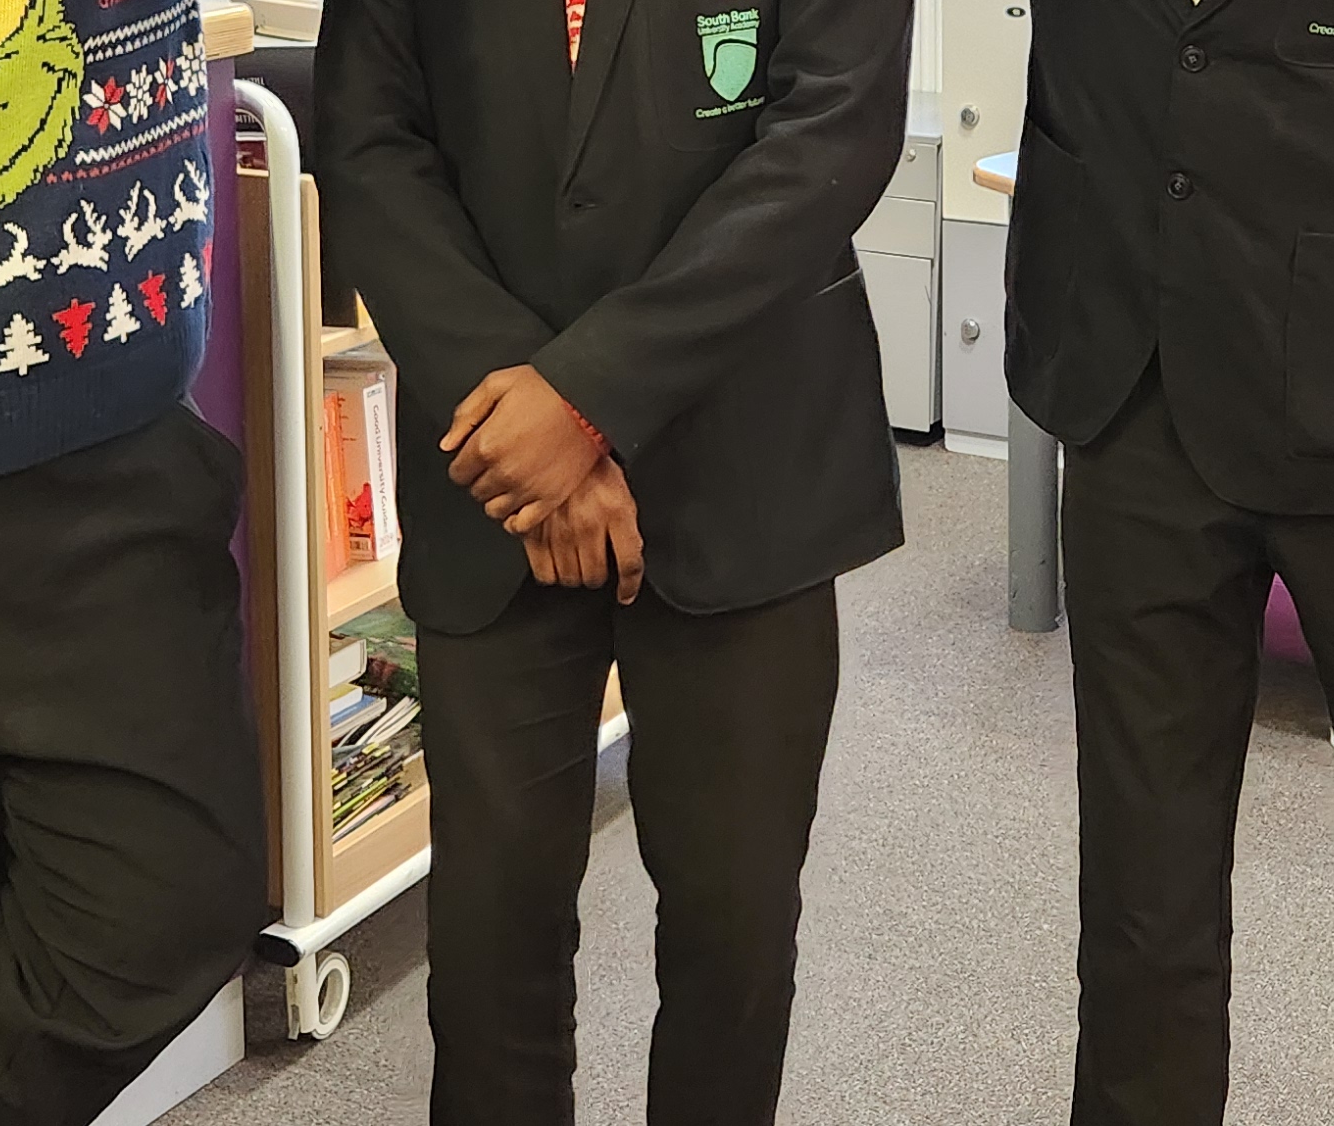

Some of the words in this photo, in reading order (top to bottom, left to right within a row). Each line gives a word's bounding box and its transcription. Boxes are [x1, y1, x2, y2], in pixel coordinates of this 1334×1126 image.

[697, 13, 731, 27] South
[730, 8, 760, 22] Bank
[696, 107, 722, 118] Create
[722, 106, 728, 114] a
[375, 435, 386, 494] University
